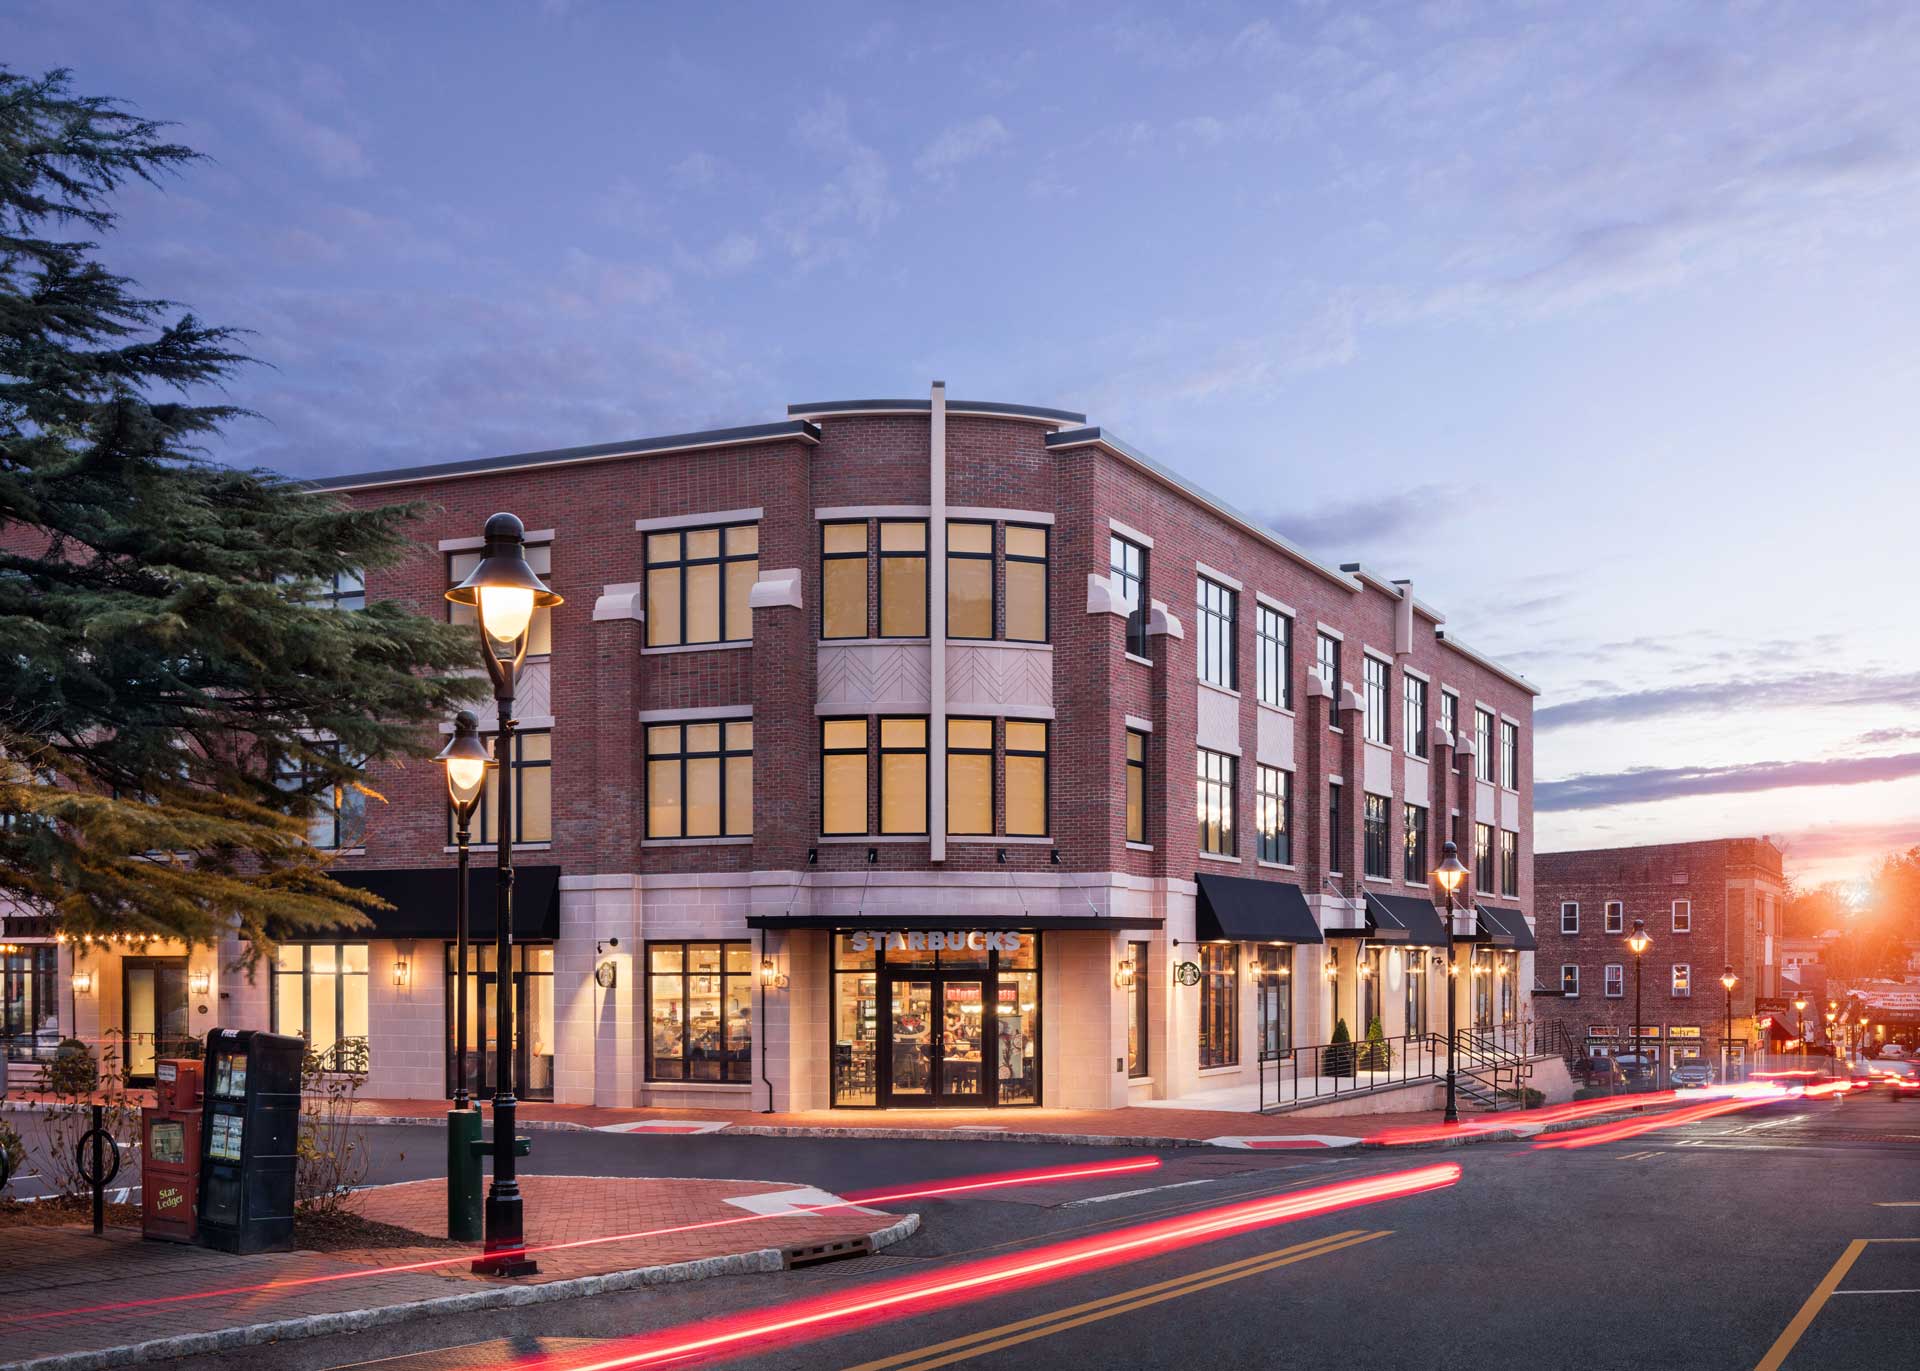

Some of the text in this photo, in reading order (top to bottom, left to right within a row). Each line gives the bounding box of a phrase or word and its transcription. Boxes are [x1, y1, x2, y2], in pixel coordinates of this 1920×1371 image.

[853, 931, 1021, 951] STARBUCKS
[221, 1029, 240, 1038] FREE
[159, 1187, 178, 1199] Star-
[157, 1195, 183, 1211] Ledger
